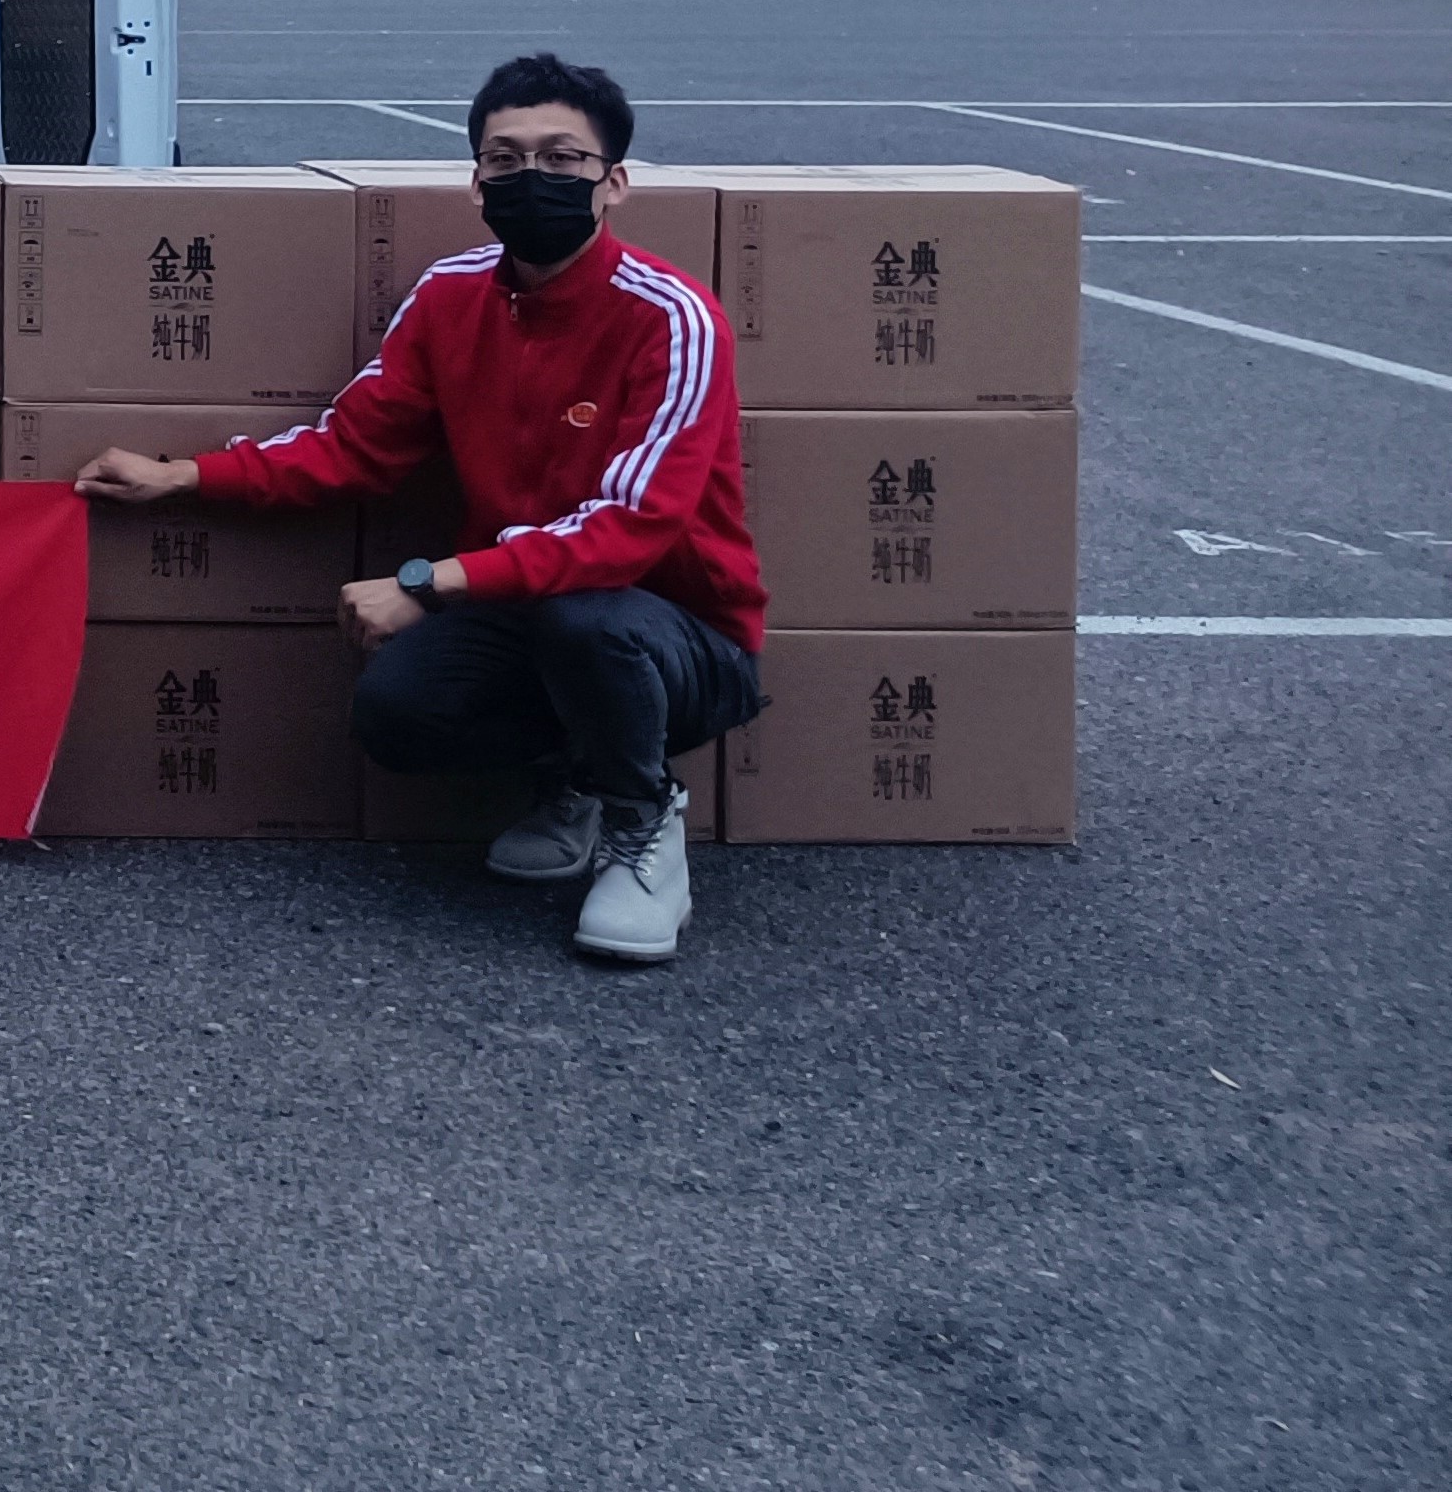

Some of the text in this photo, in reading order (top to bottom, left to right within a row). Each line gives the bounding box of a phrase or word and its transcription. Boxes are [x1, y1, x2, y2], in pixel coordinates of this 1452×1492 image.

[147, 236, 216, 283] 金典
[871, 241, 940, 288] 金典
[148, 285, 215, 301] SATINE
[872, 289, 939, 305] SATINE
[151, 314, 211, 361] 纯牛奶
[874, 318, 935, 366] 纯牛奶
[867, 458, 936, 506] 金典
[868, 508, 935, 524] SATINE
[151, 530, 210, 579] 纯牛奶
[871, 536, 932, 584] 纯牛奶
[153, 669, 222, 717] 金典
[868, 675, 938, 723] 金典
[155, 718, 220, 734] SATINE
[869, 724, 936, 740] SATINE
[157, 745, 218, 794] 纯牛奶
[872, 753, 933, 801] 纯牛奶
